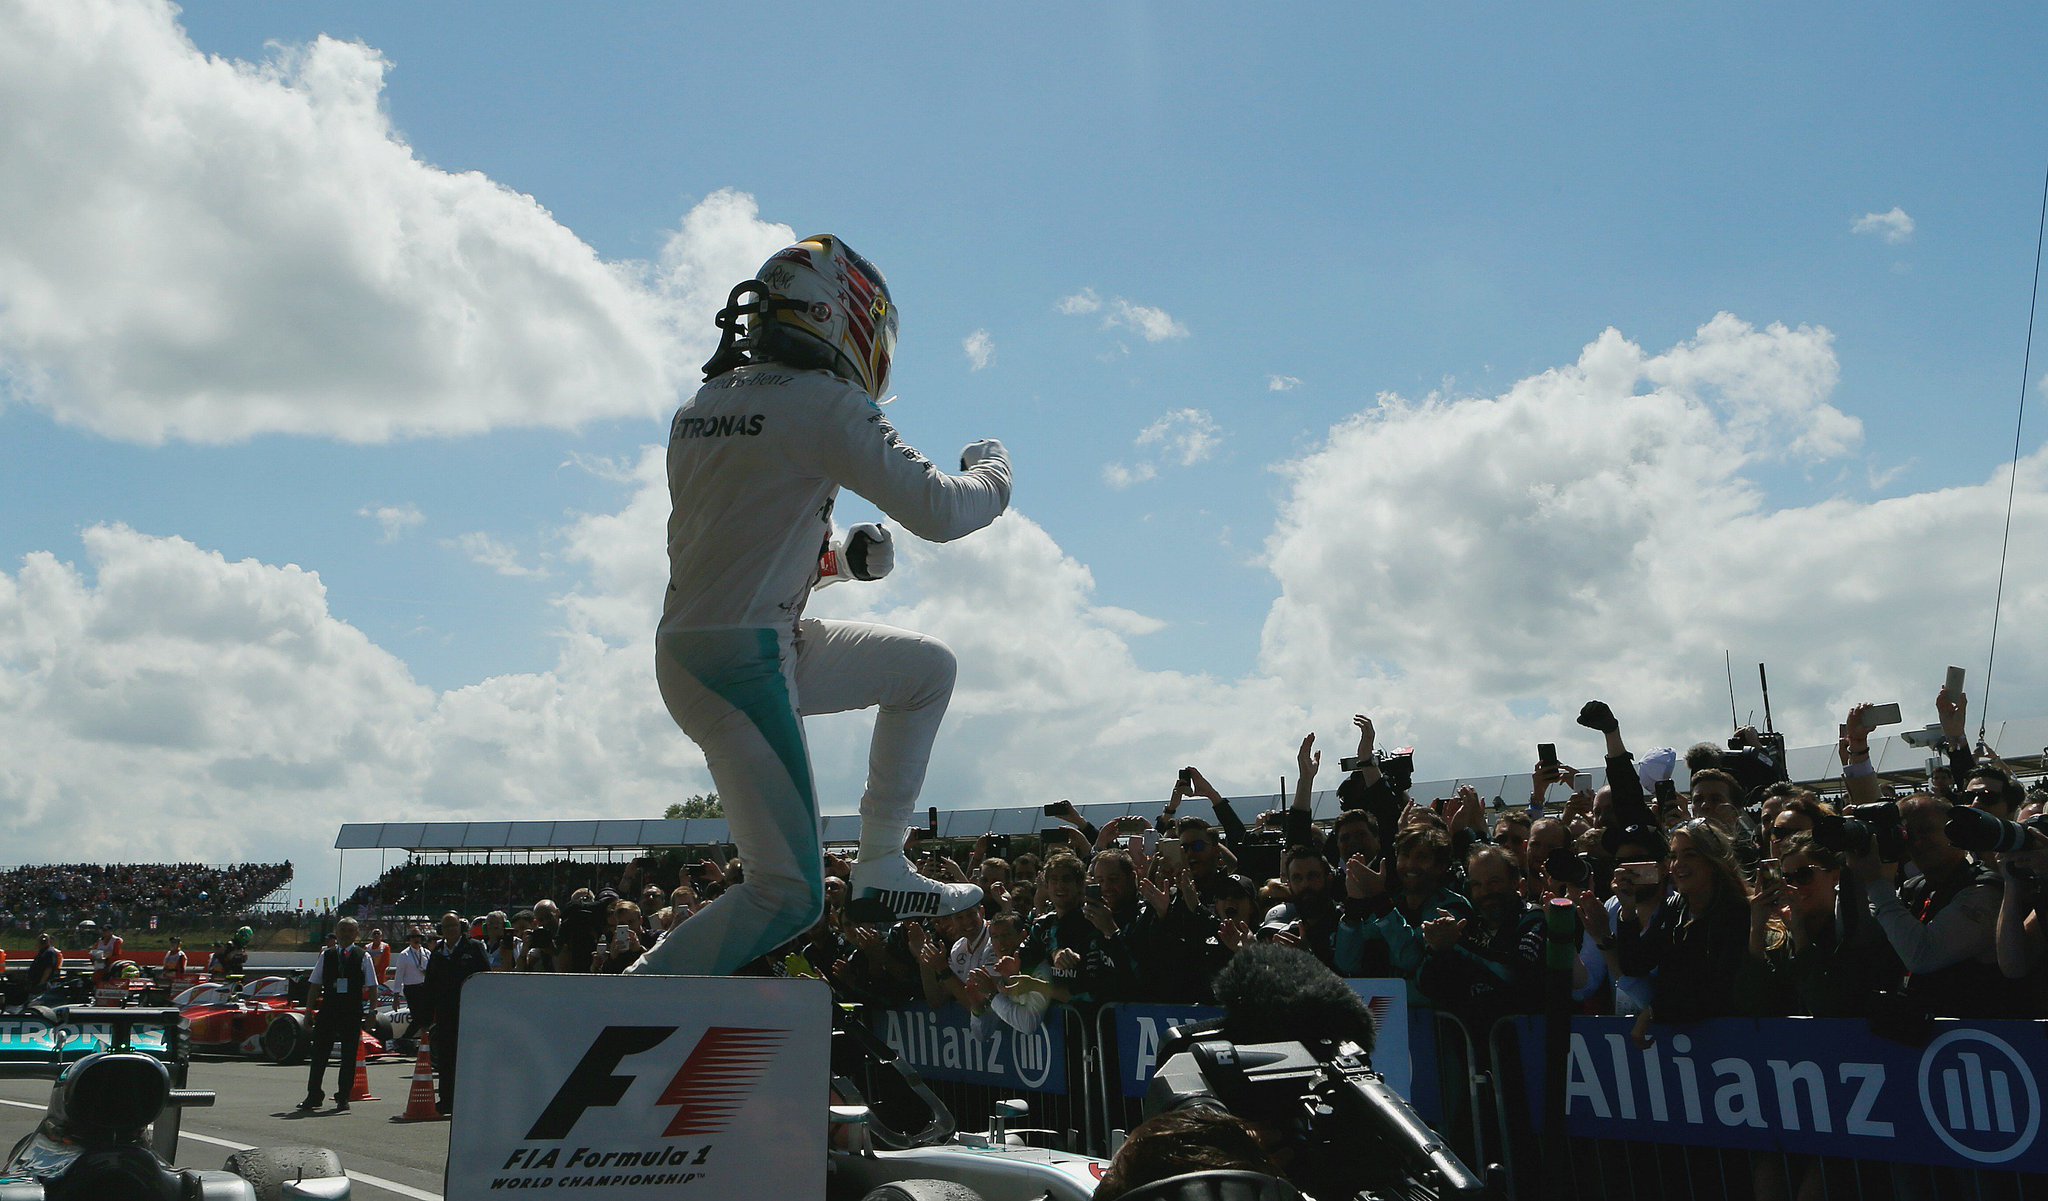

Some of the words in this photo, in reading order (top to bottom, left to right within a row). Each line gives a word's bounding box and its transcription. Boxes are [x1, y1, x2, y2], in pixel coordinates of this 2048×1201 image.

[672, 414, 766, 440] ETRONAS
[886, 1010, 1004, 1074] Allianz
[524, 1026, 793, 1139] F1
[1565, 1033, 1895, 1138] Allianz
[502, 1148, 561, 1170] FIA
[565, 1142, 693, 1168] Formula
[691, 1145, 712, 1165] 1
[490, 1177, 553, 1190] WORLD
